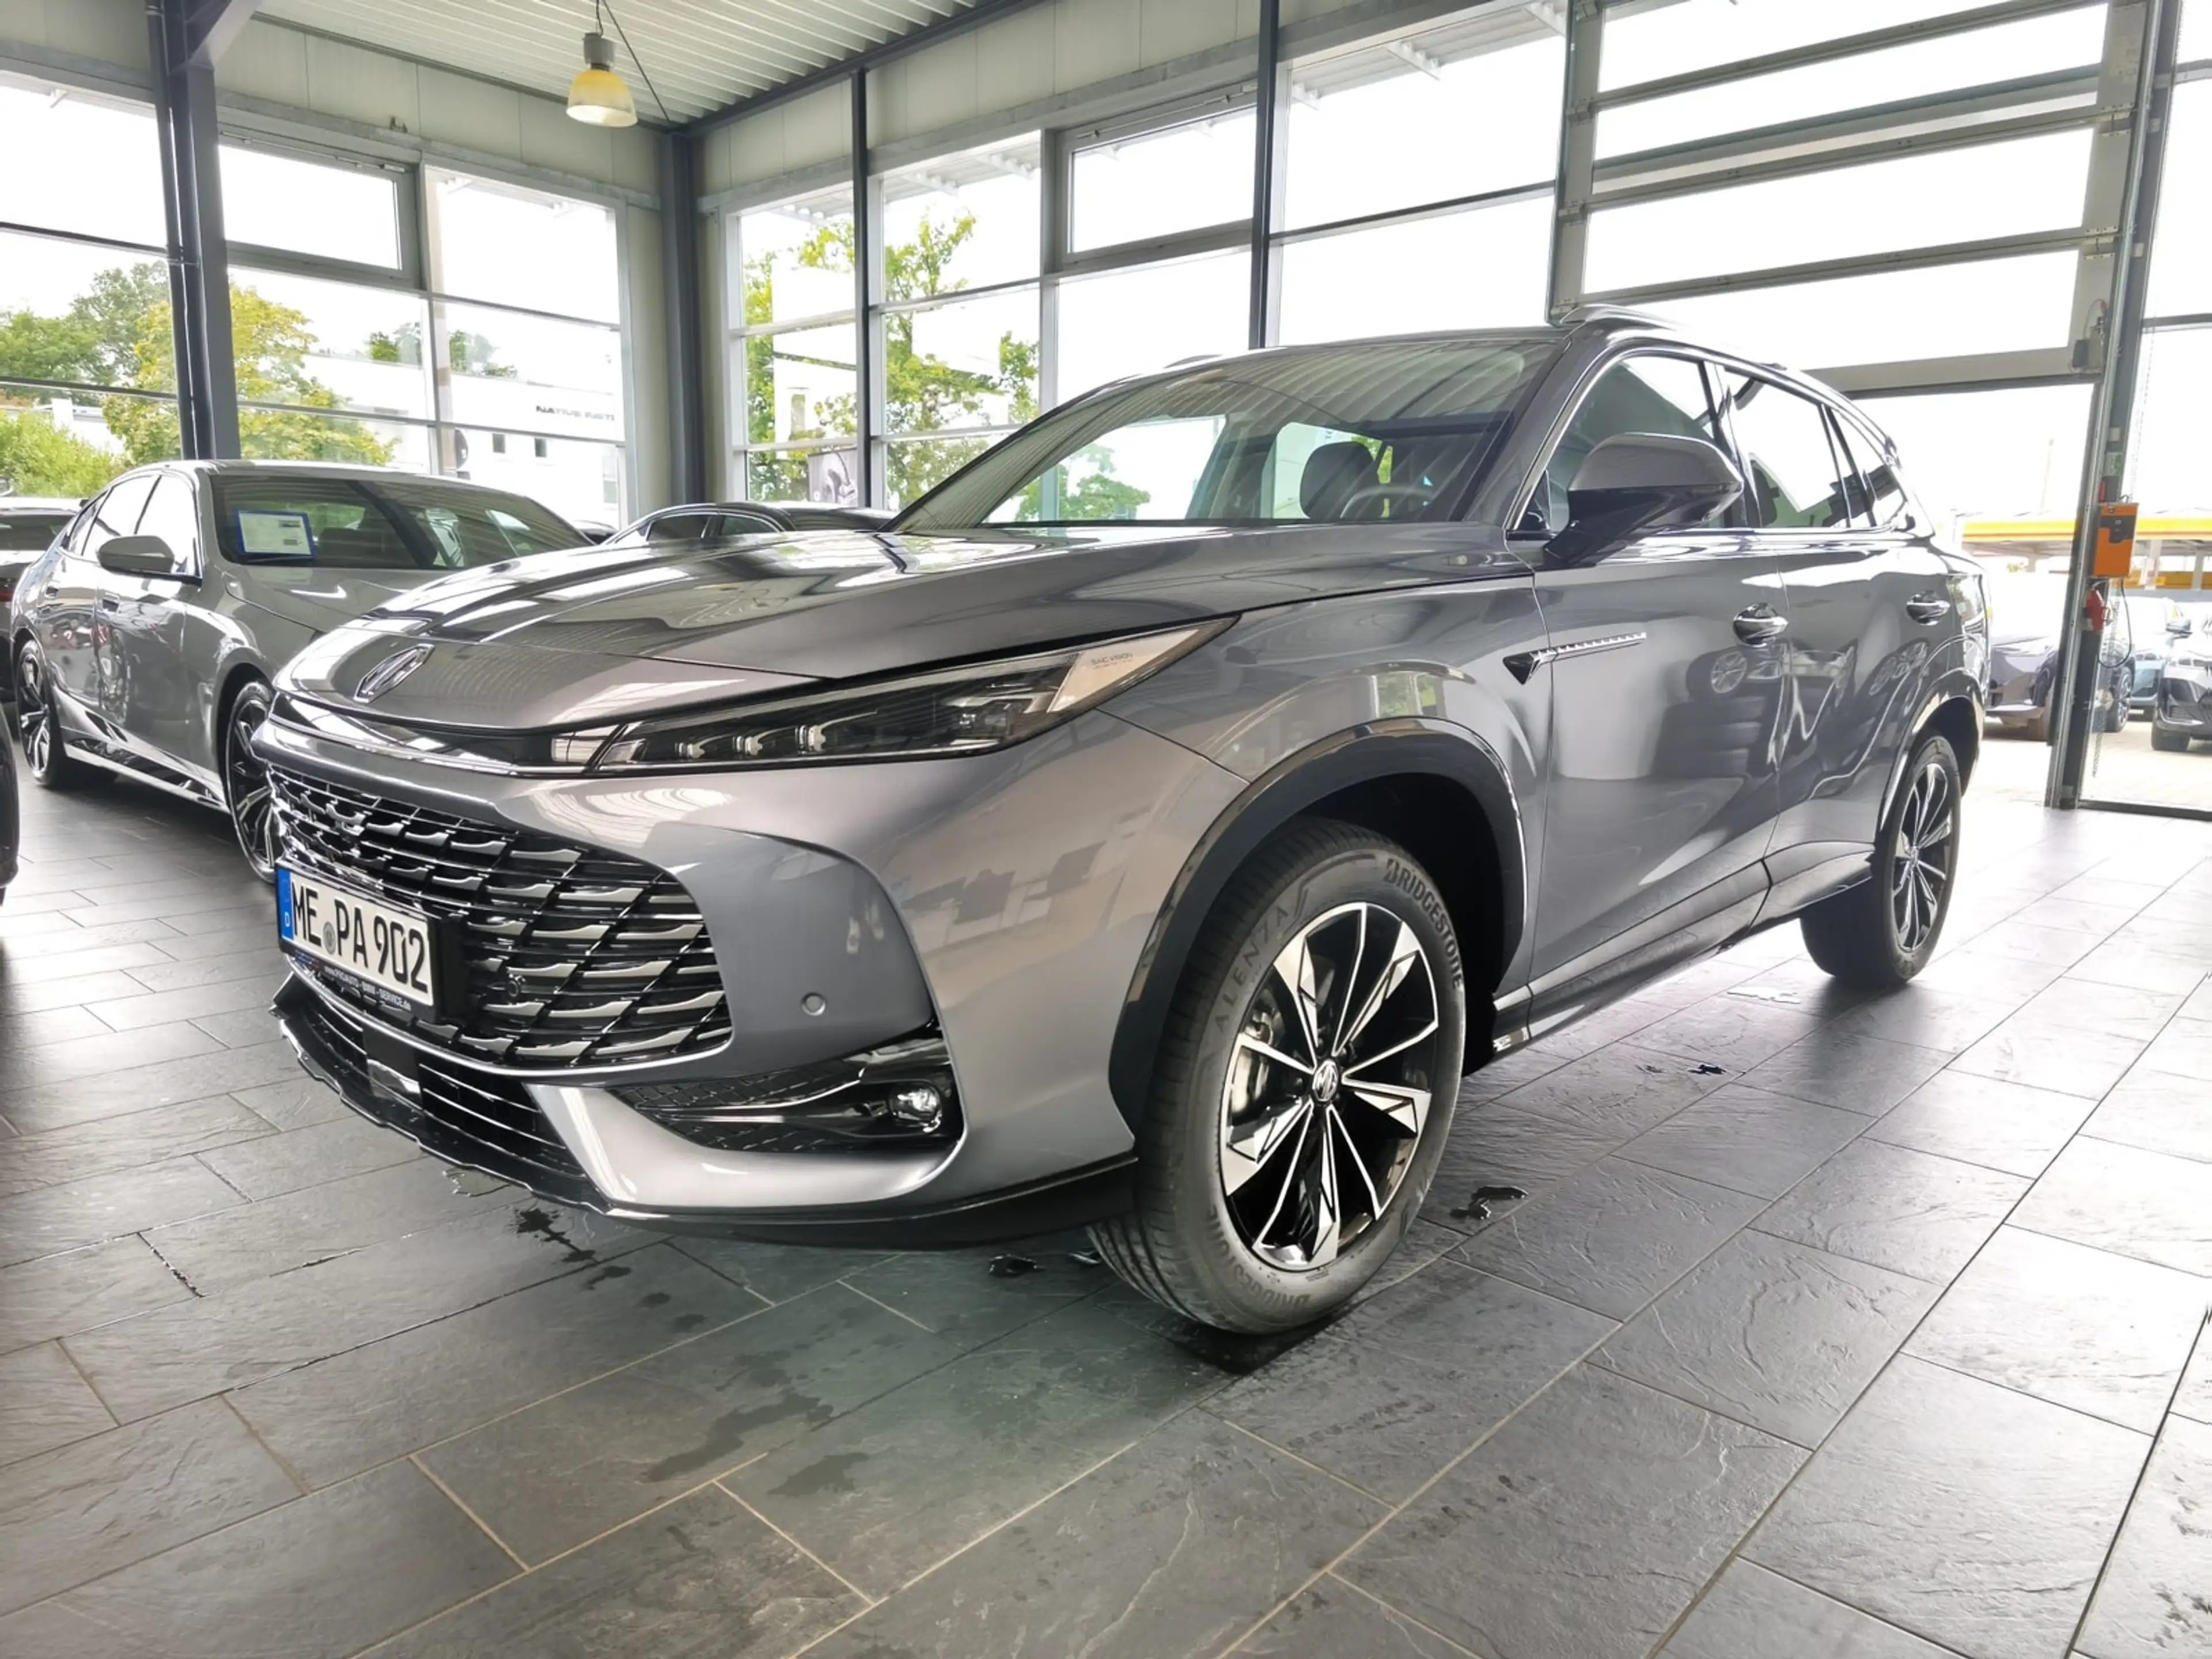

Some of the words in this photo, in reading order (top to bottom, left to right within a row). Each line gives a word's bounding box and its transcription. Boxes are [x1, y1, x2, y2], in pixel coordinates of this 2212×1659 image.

[291, 881, 321, 947] ME
[334, 898, 369, 968] PA
[373, 915, 428, 994] 902
[1215, 906, 1289, 1030] ALENZA
[1384, 859, 1463, 989] BRIDGESTONE
